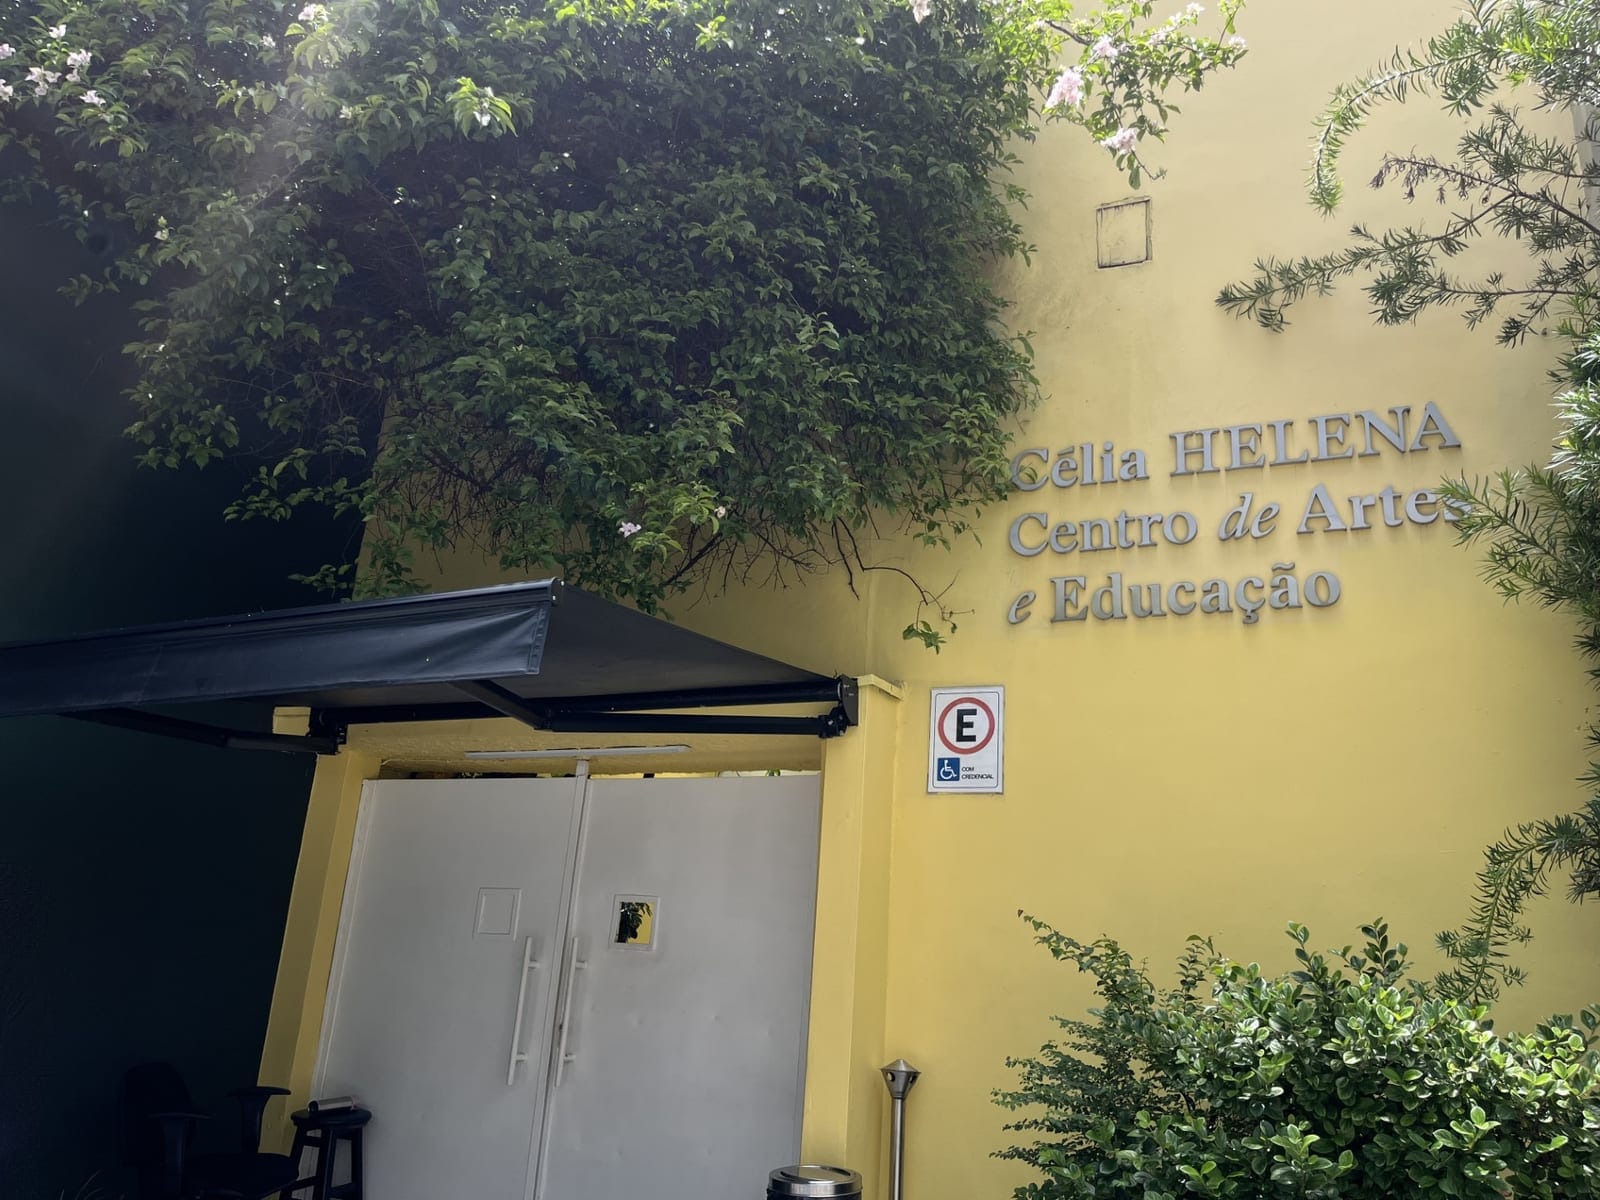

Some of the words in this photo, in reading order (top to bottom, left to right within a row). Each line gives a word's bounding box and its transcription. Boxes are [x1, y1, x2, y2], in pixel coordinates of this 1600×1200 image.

[1010, 442, 1149, 492] Célia
[1170, 401, 1462, 477] HELENA
[1008, 510, 1197, 556] Centro
[1218, 493, 1280, 541] de
[1007, 590, 1036, 625] e
[1050, 562, 1342, 624] Educação
[956, 708, 977, 742] E
